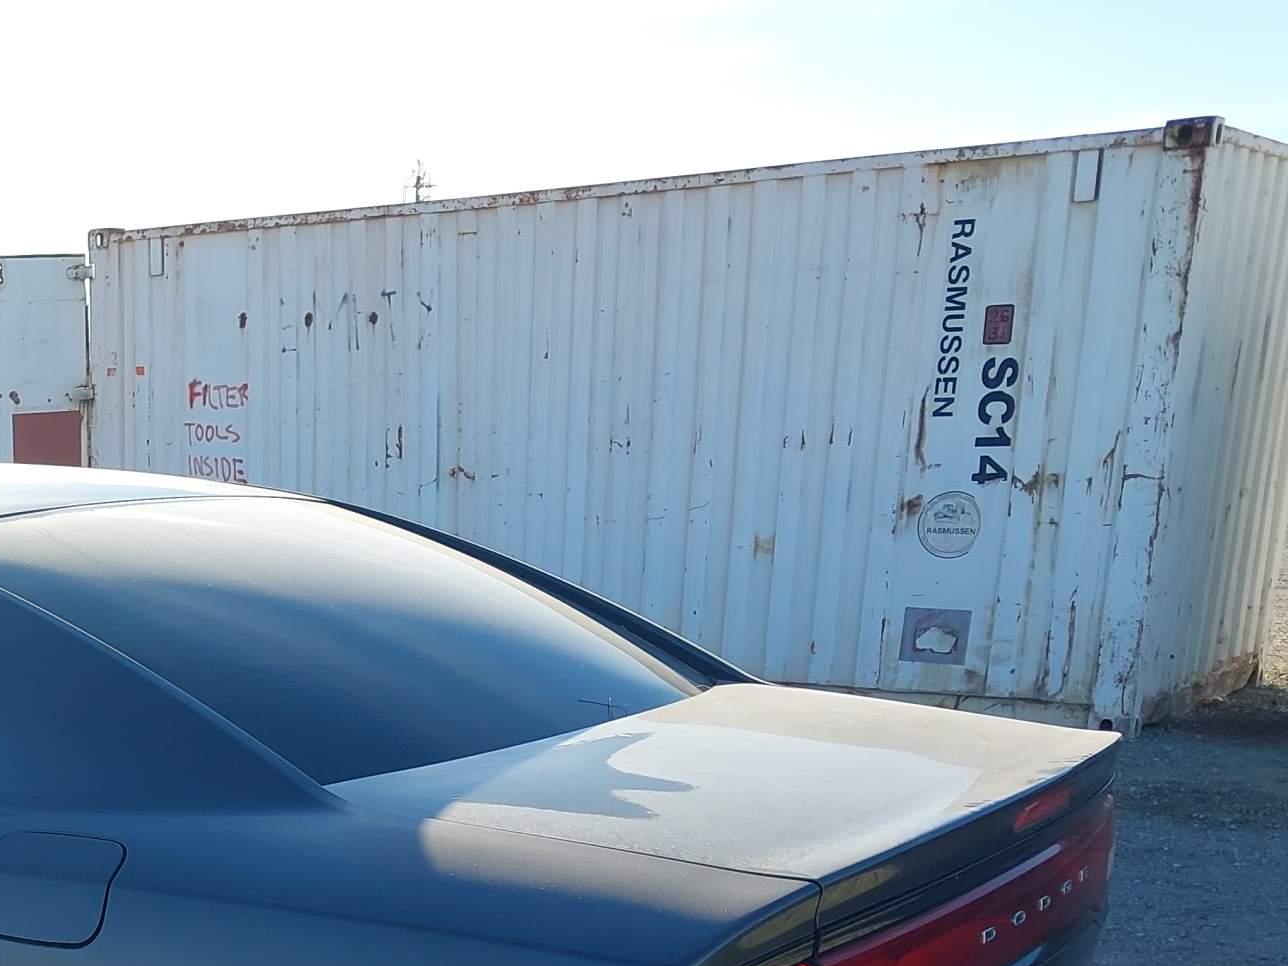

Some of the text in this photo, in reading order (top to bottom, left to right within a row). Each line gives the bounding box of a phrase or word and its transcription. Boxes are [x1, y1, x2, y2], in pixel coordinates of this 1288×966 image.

[932, 218, 976, 417] RASMUSSEN
[188, 379, 248, 410] FILTER
[184, 422, 240, 447] TOOLS
[971, 357, 1019, 485] SC14
[188, 454, 248, 484] INSIDE
[926, 527, 976, 535] RASMUSSEN
